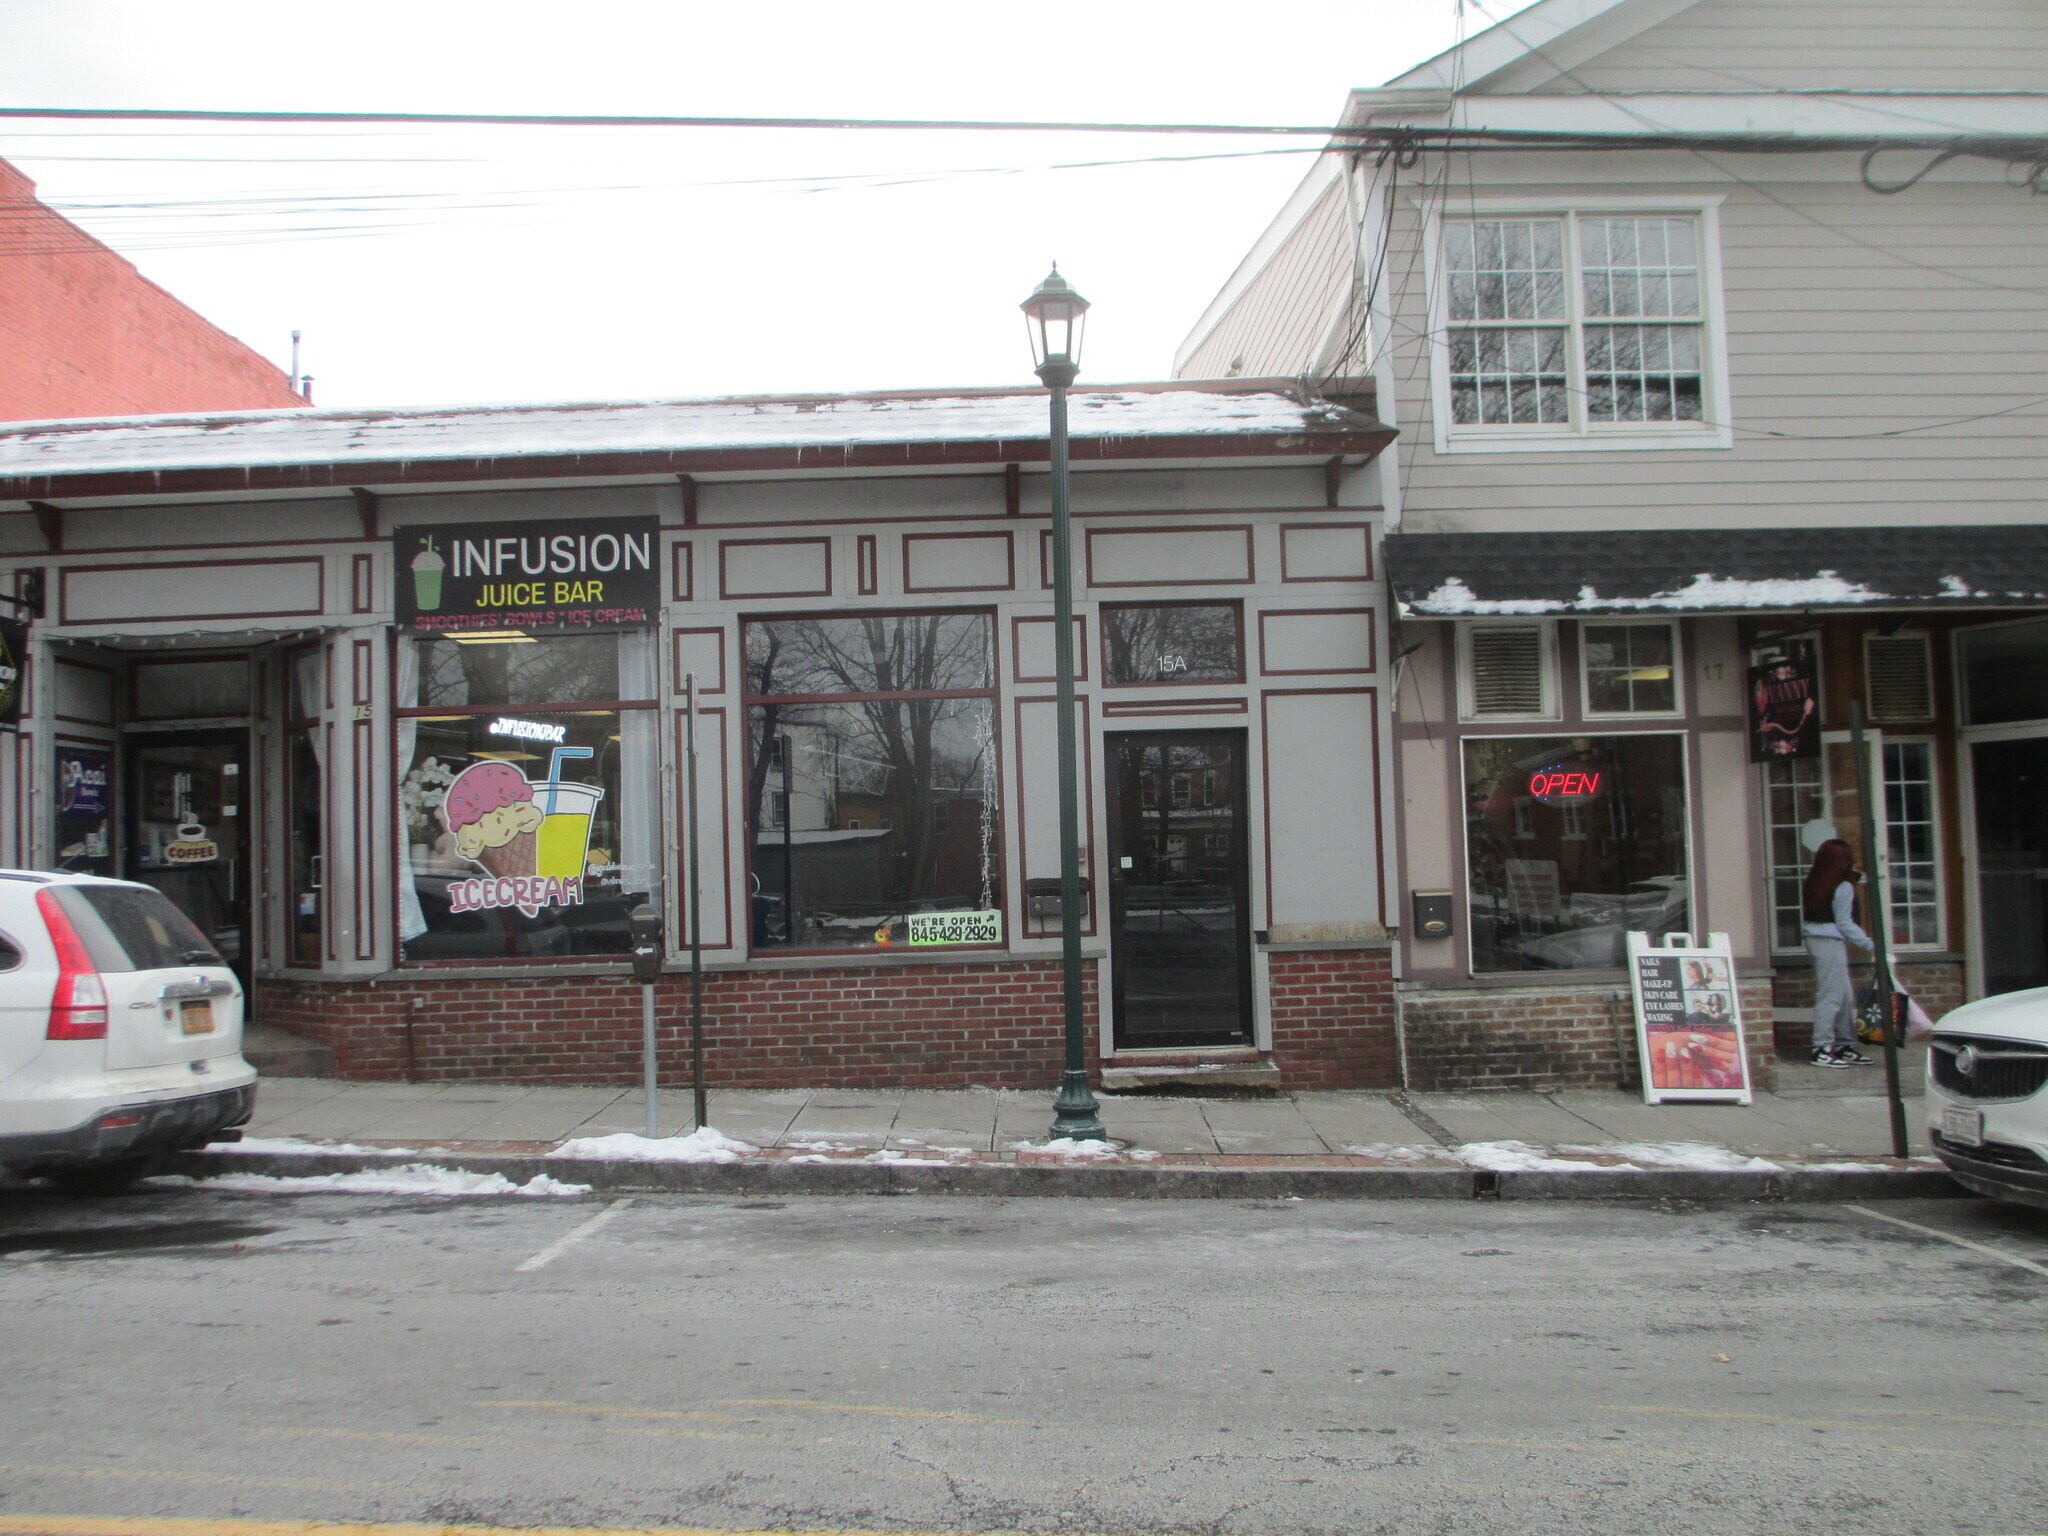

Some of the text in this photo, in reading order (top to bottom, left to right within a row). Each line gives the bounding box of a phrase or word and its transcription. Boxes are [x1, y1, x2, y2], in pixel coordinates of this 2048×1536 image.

[453, 533, 650, 577] INFUSION
[476, 580, 604, 607] JUICE BAR
[415, 607, 646, 630] SMOOTHIES BOWLS ICE CREAM
[1157, 655, 1187, 672] 15A
[1703, 663, 1723, 680] 17
[355, 704, 372, 719] 15
[1530, 773, 1599, 795] OPEN
[169, 846, 216, 859] COFFEE
[450, 875, 583, 912] ICECREAM
[911, 916, 982, 926] WE'RE OPEN
[911, 925, 997, 942] 845-429-2929
[1640, 958, 1660, 966] NAILS
[1641, 969, 1659, 977] HAIR
[1643, 980, 1673, 988] MAKE-UP
[1644, 991, 1678, 999] SKIN CARE
[1645, 1002, 1684, 1010] EYE LASHES
